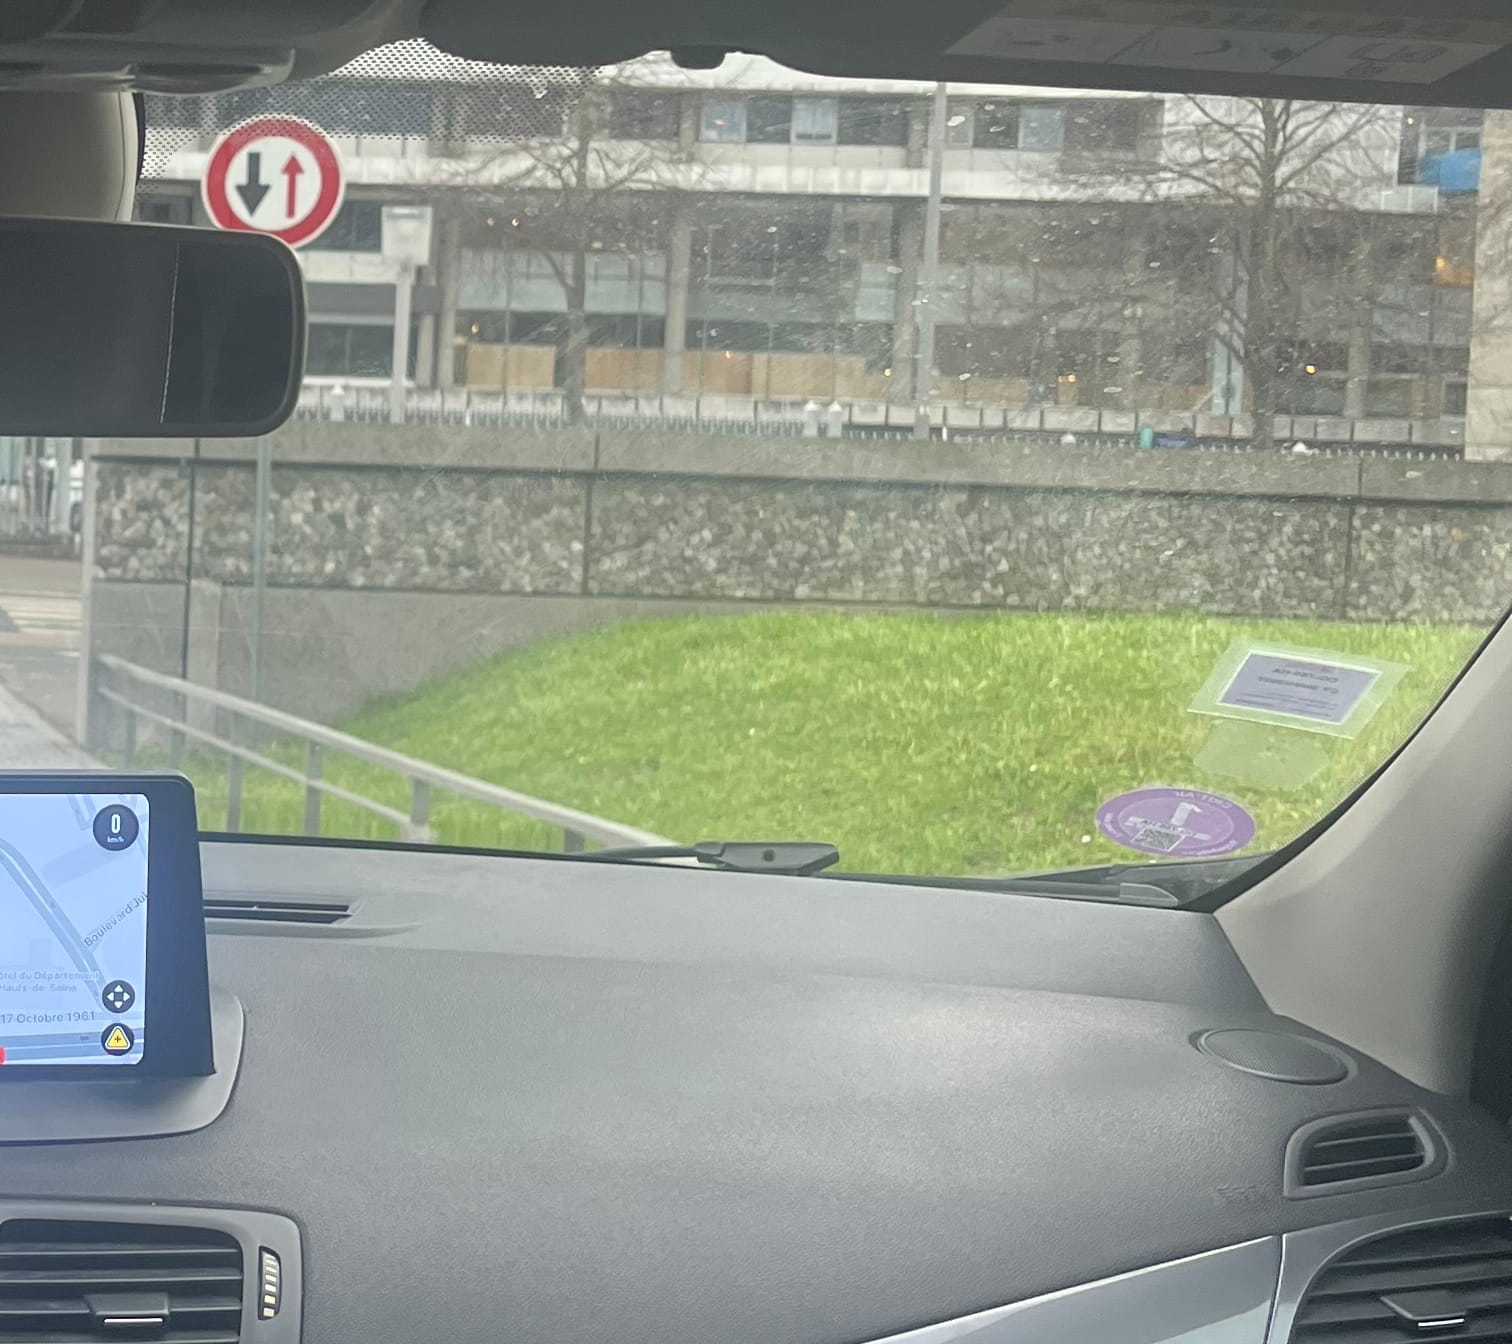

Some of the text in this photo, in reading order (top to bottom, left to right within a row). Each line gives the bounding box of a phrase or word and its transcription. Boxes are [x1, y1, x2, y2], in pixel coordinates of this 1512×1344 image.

[111, 814, 121, 834] 0
[84, 903, 133, 947] Boulevard
[20, 971, 32, 980] du
[34, 971, 99, 982] Département
[1, 1013, 14, 1024] 17
[17, 1011, 64, 1023] Octobre
[68, 1010, 96, 1022] 1961
